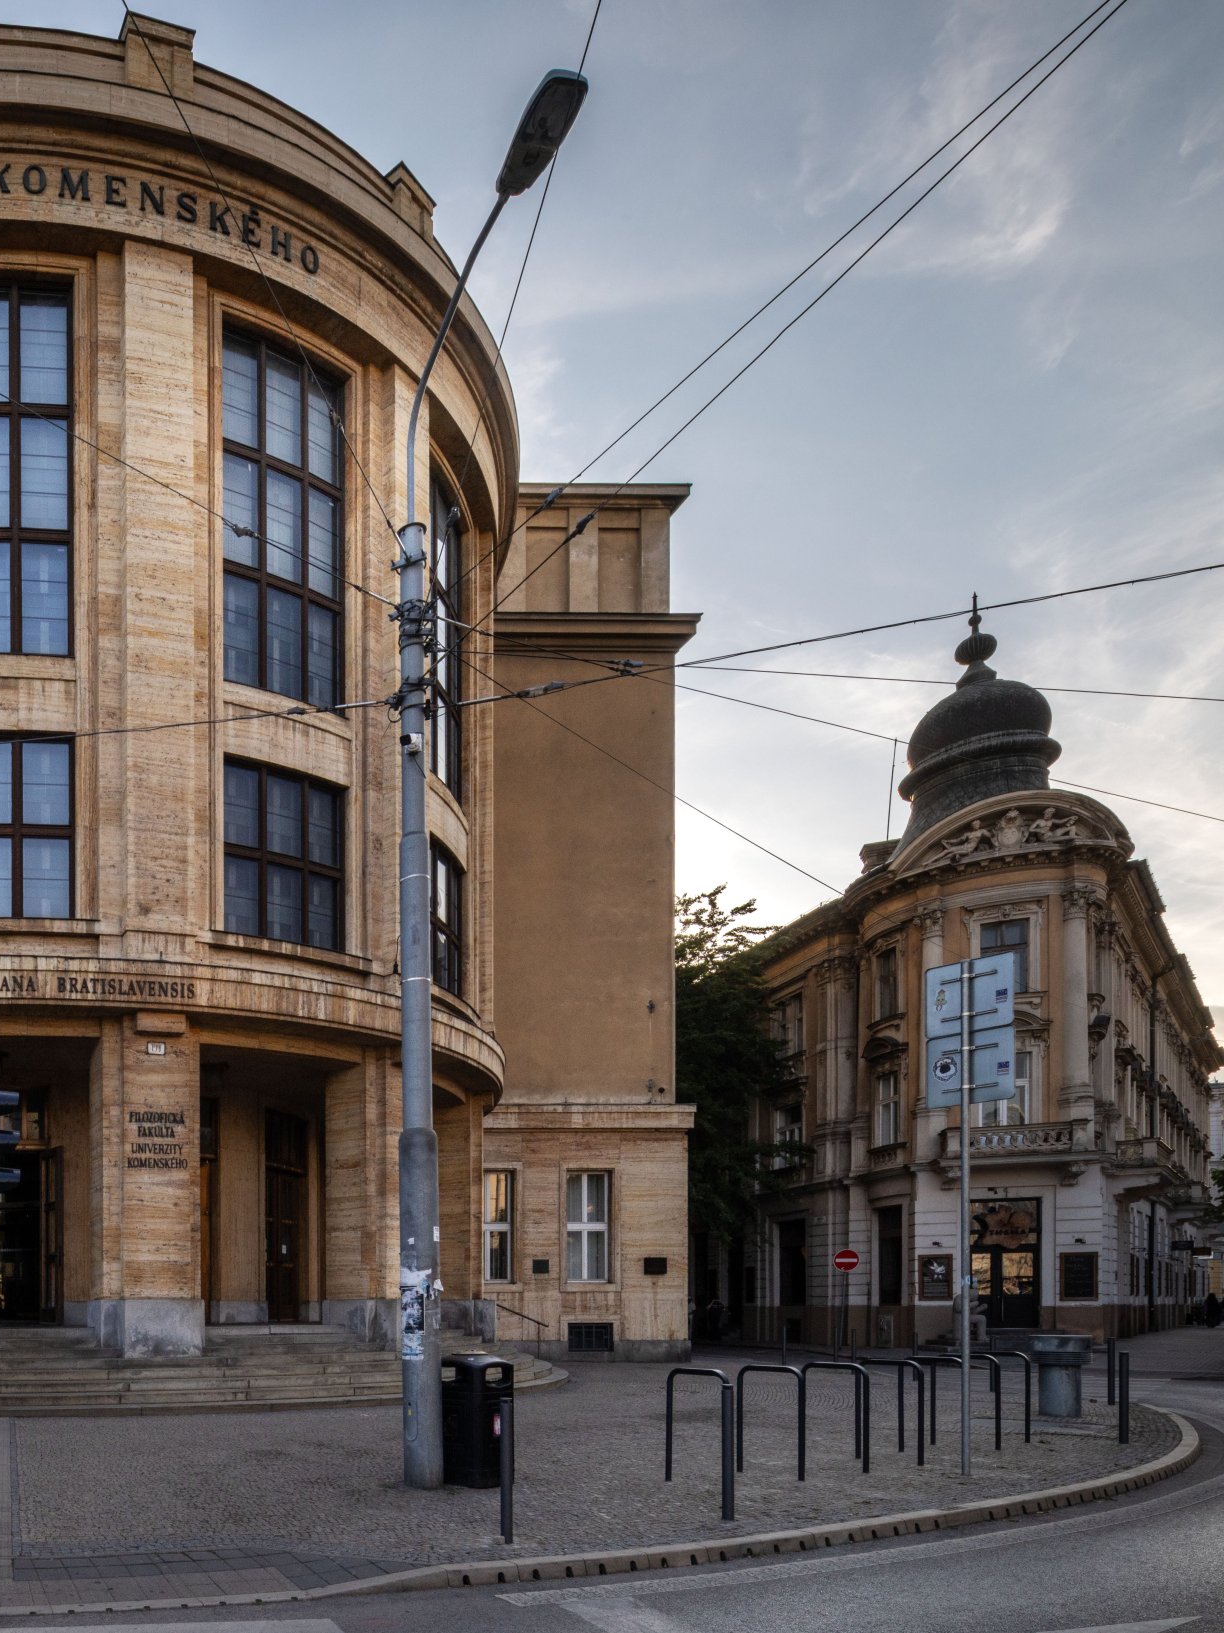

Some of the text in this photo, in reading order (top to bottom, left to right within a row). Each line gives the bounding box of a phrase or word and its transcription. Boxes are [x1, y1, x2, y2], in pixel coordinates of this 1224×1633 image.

[57, 976, 196, 999] BRATISLAVENSIS
[137, 1125, 176, 1138] FAKULTA
[131, 1142, 184, 1155] UNIVERZITY
[127, 1156, 189, 1169] KOMENSKÉHO
